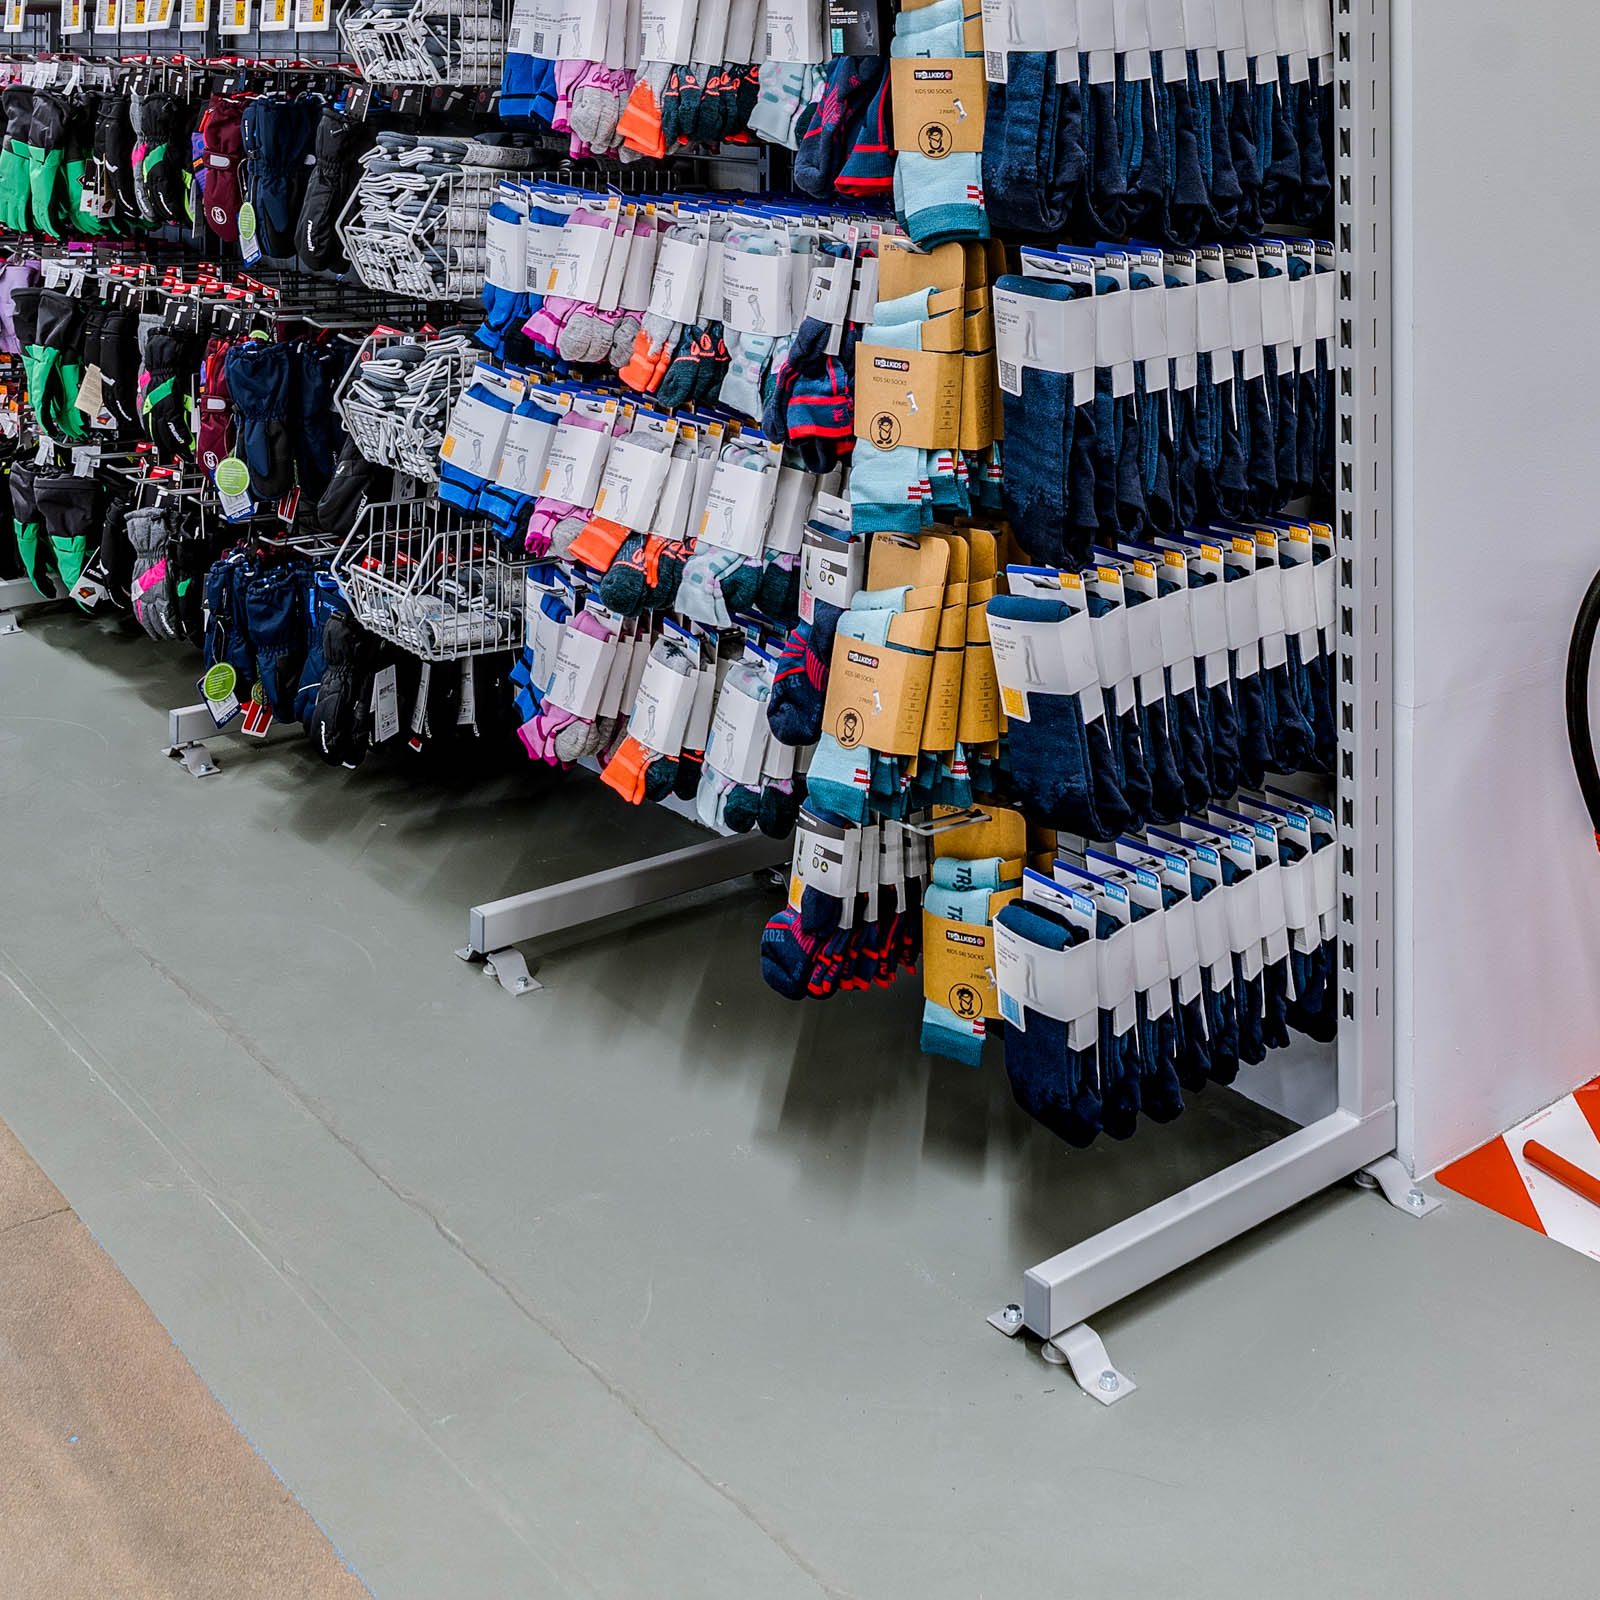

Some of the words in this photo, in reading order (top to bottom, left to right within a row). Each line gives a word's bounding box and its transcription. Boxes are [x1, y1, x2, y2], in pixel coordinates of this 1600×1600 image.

[915, 71, 945, 80] TROLLKIDS
[1202, 246, 1219, 258] 31/34
[1234, 247, 1251, 258] 31/34
[1264, 245, 1281, 254] 31/34
[1293, 243, 1310, 253] 31/34
[1106, 256, 1123, 266] 31/34
[1141, 253, 1158, 265] 31/34
[1174, 253, 1192, 265] 31/34
[1071, 261, 1090, 274] 31/34
[875, 358, 902, 369] TROLLKIDS
[946, 932, 977, 944] TROLLKIDS
[946, 948, 957, 956] KIDS
[958, 950, 966, 958] SKI
[966, 951, 985, 961] SOCKS
